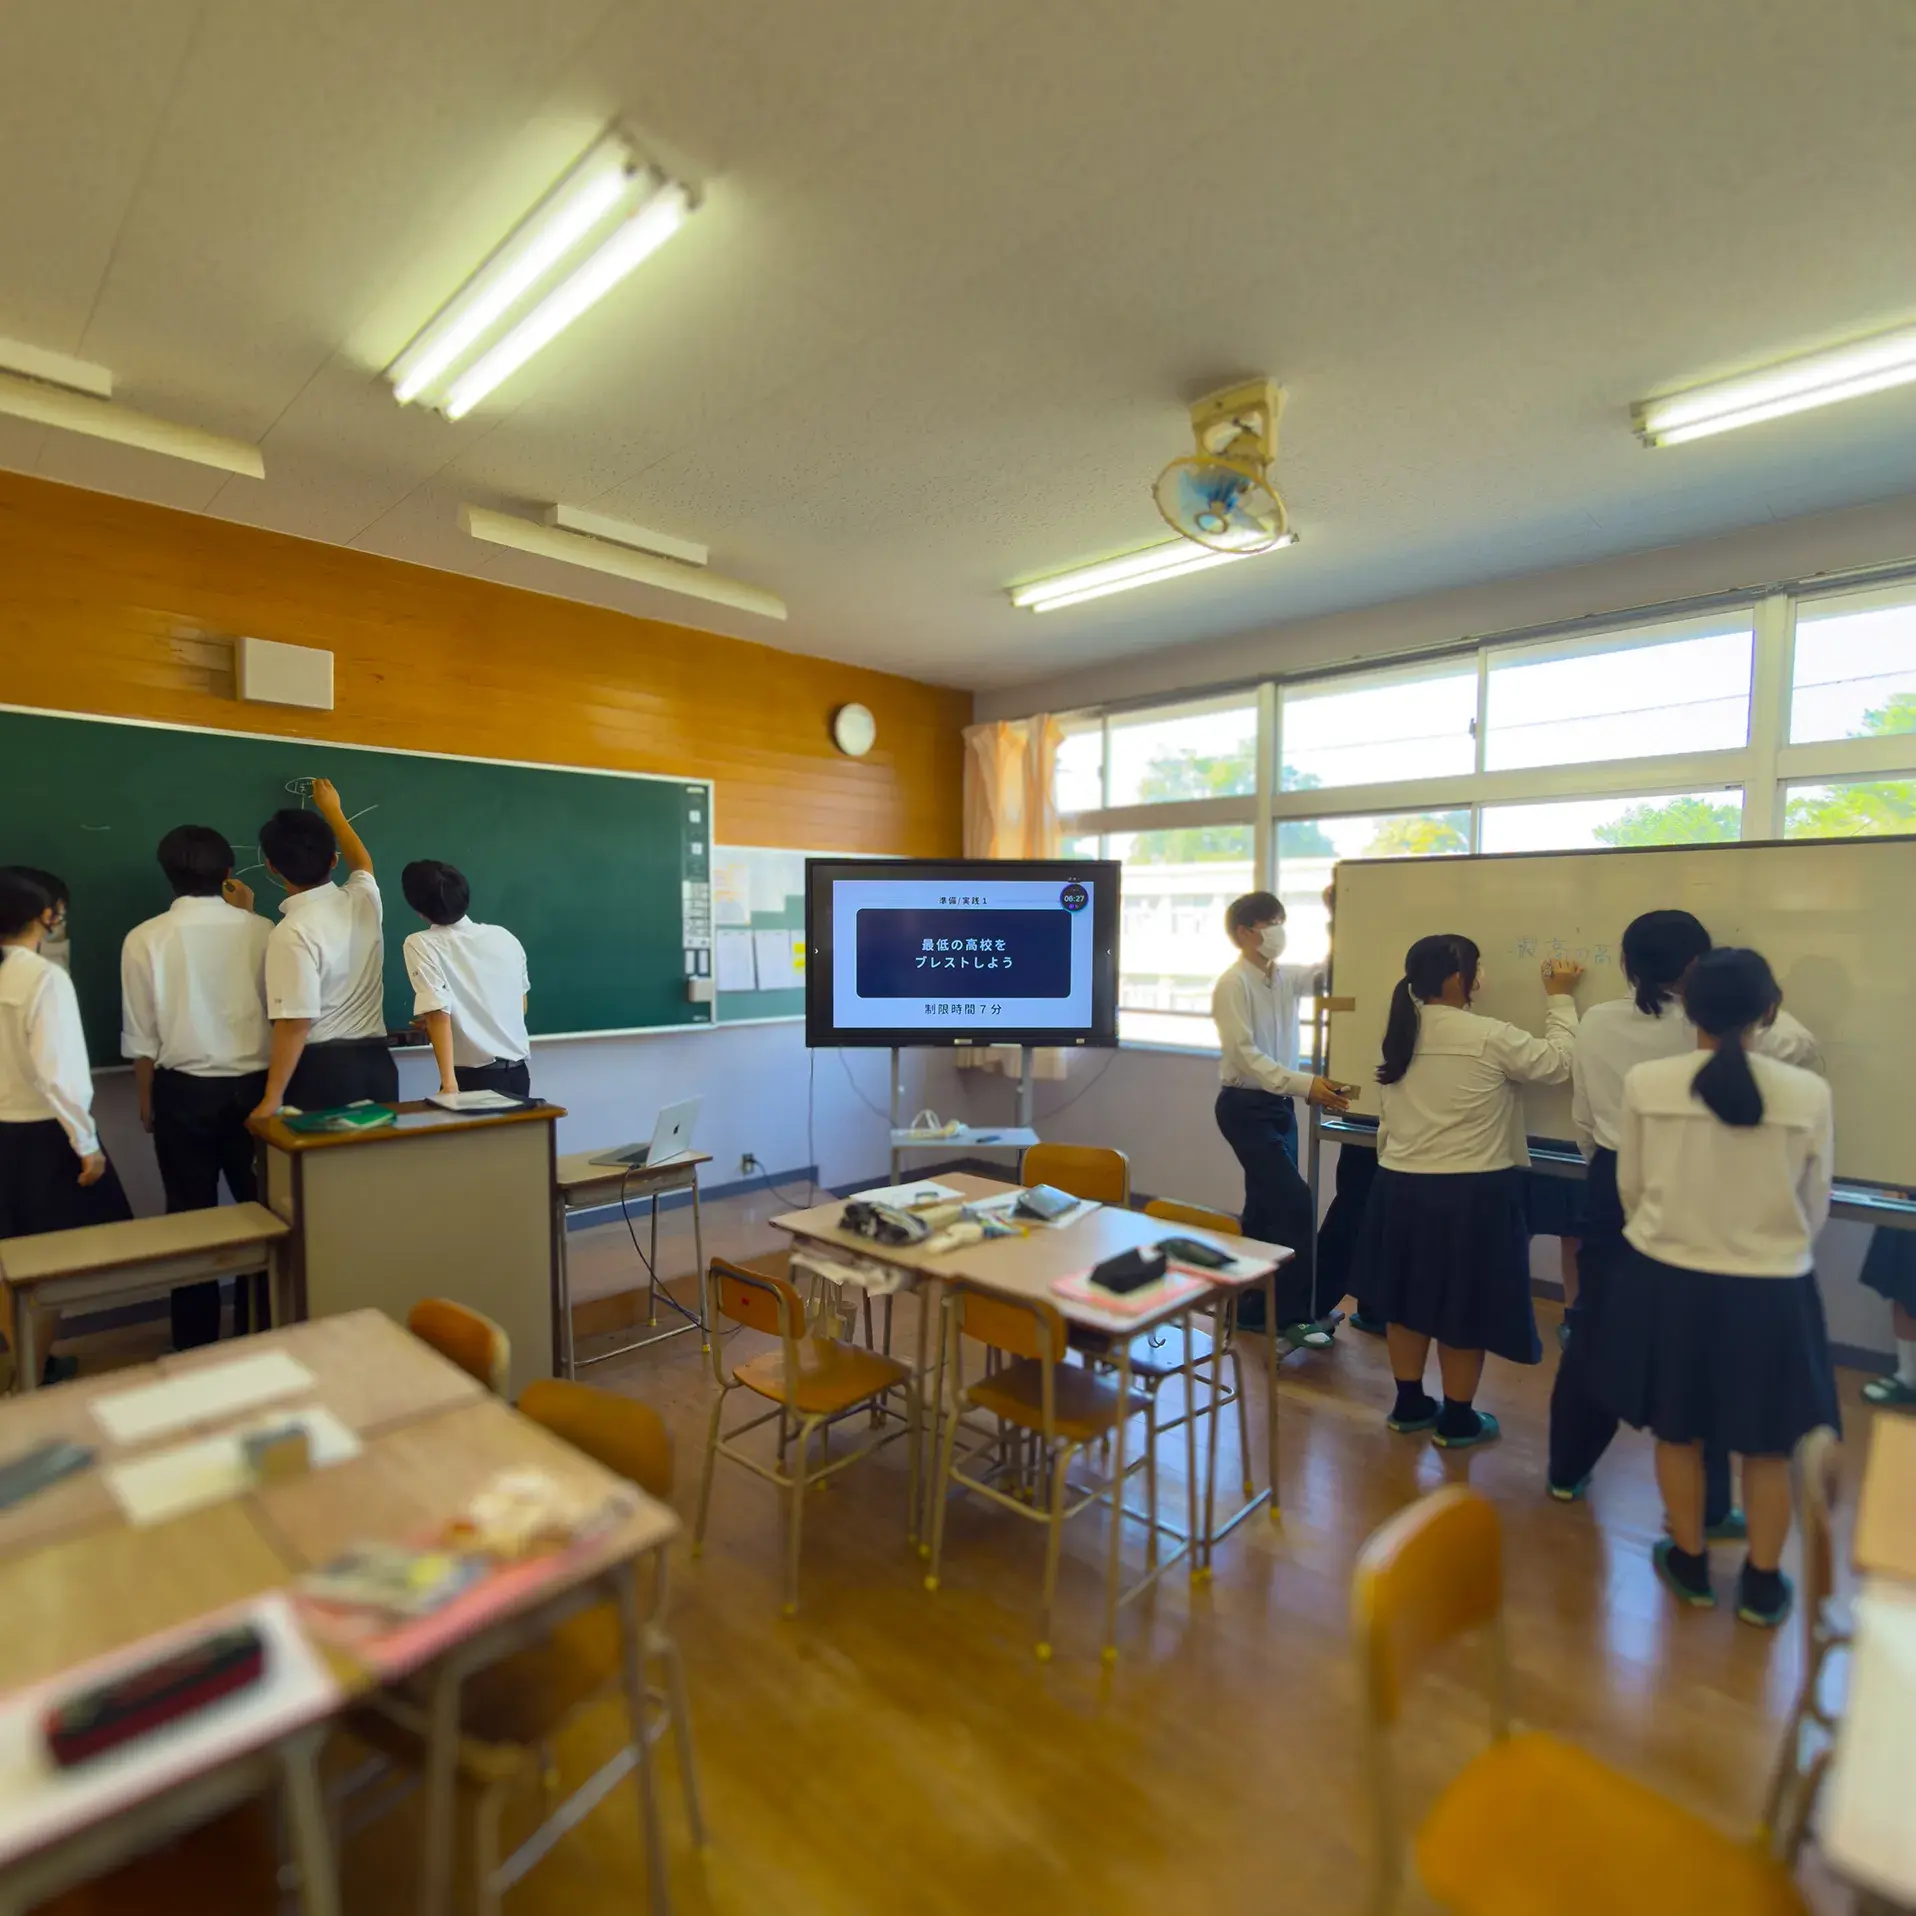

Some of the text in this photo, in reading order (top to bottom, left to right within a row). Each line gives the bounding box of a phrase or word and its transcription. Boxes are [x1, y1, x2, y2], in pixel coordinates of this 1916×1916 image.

[921, 938, 1006, 952] 最低の高校を
[915, 955, 1013, 969] ブレストしよう
[924, 1003, 1002, 1015] 制限時間7分
